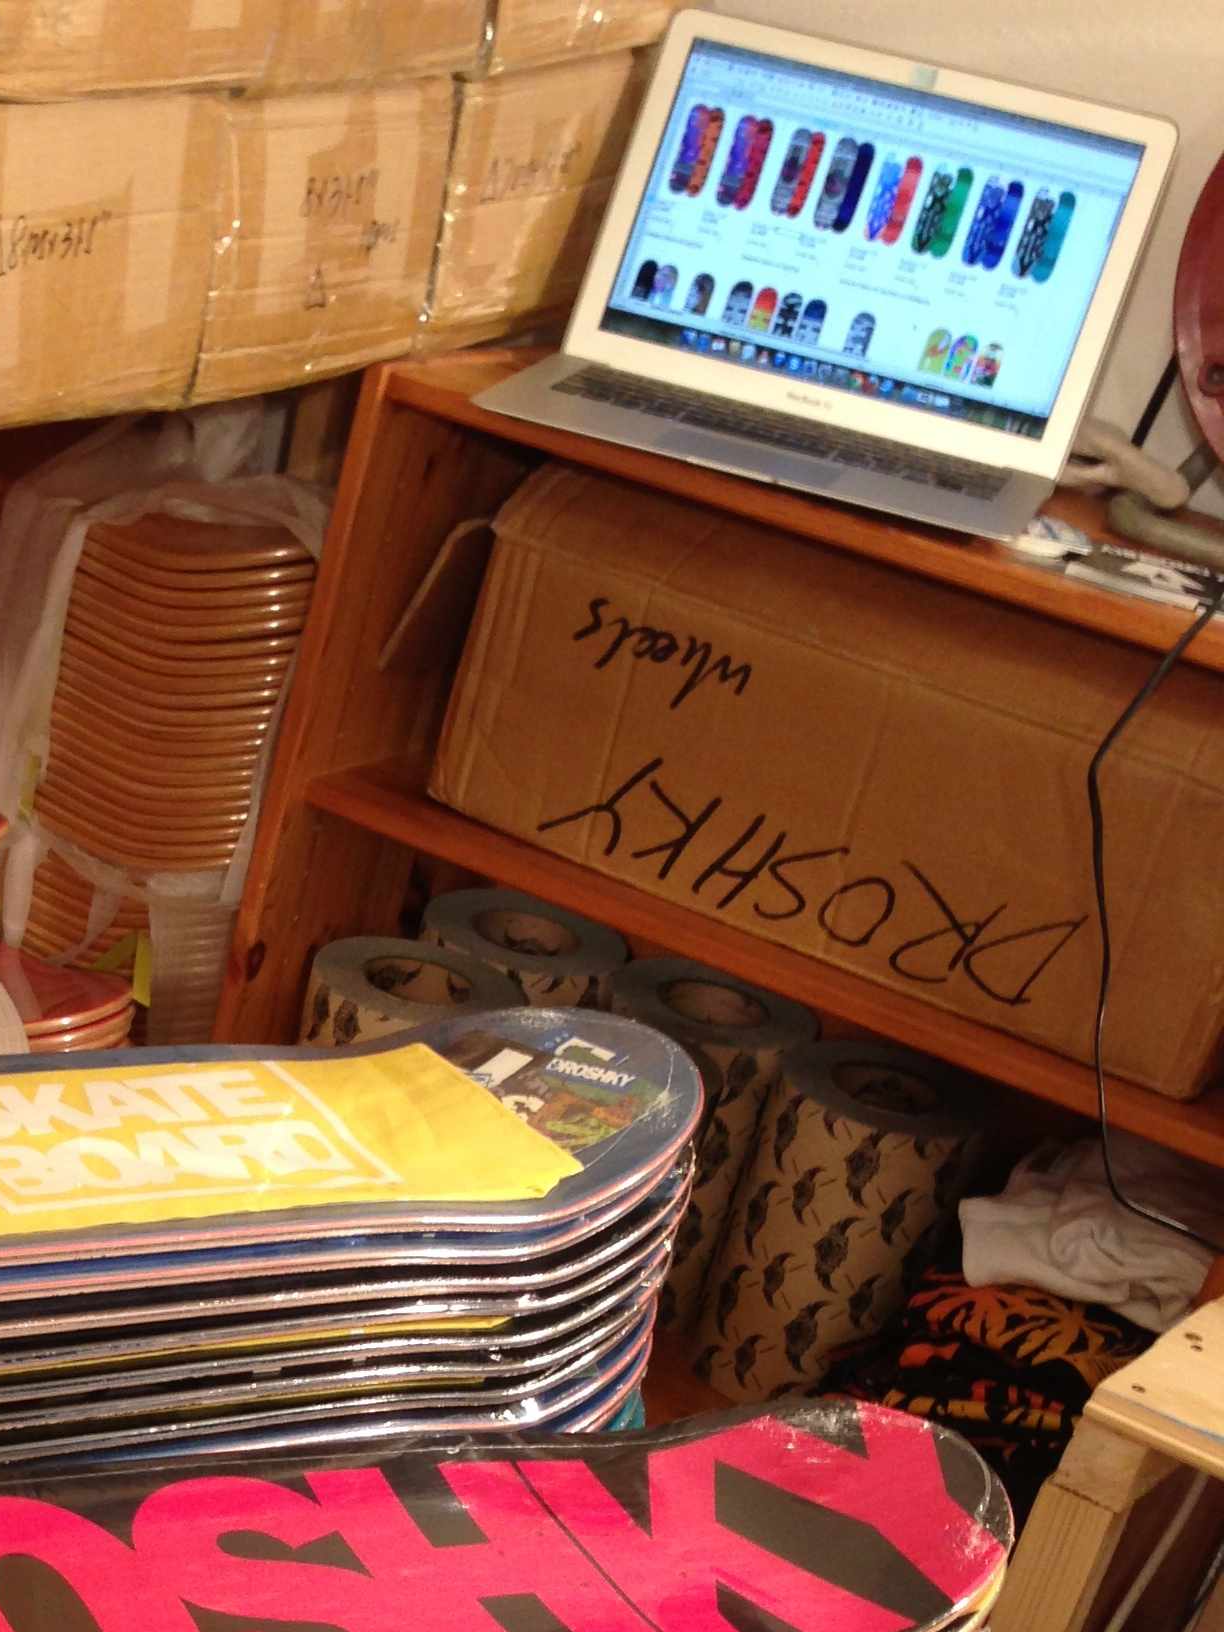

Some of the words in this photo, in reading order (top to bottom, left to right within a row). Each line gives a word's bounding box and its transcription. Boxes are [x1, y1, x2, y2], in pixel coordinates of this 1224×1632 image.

[573, 597, 753, 710] wheels
[538, 757, 1090, 1006] DROSHKY
[545, 1056, 638, 1088] DROSHKY
